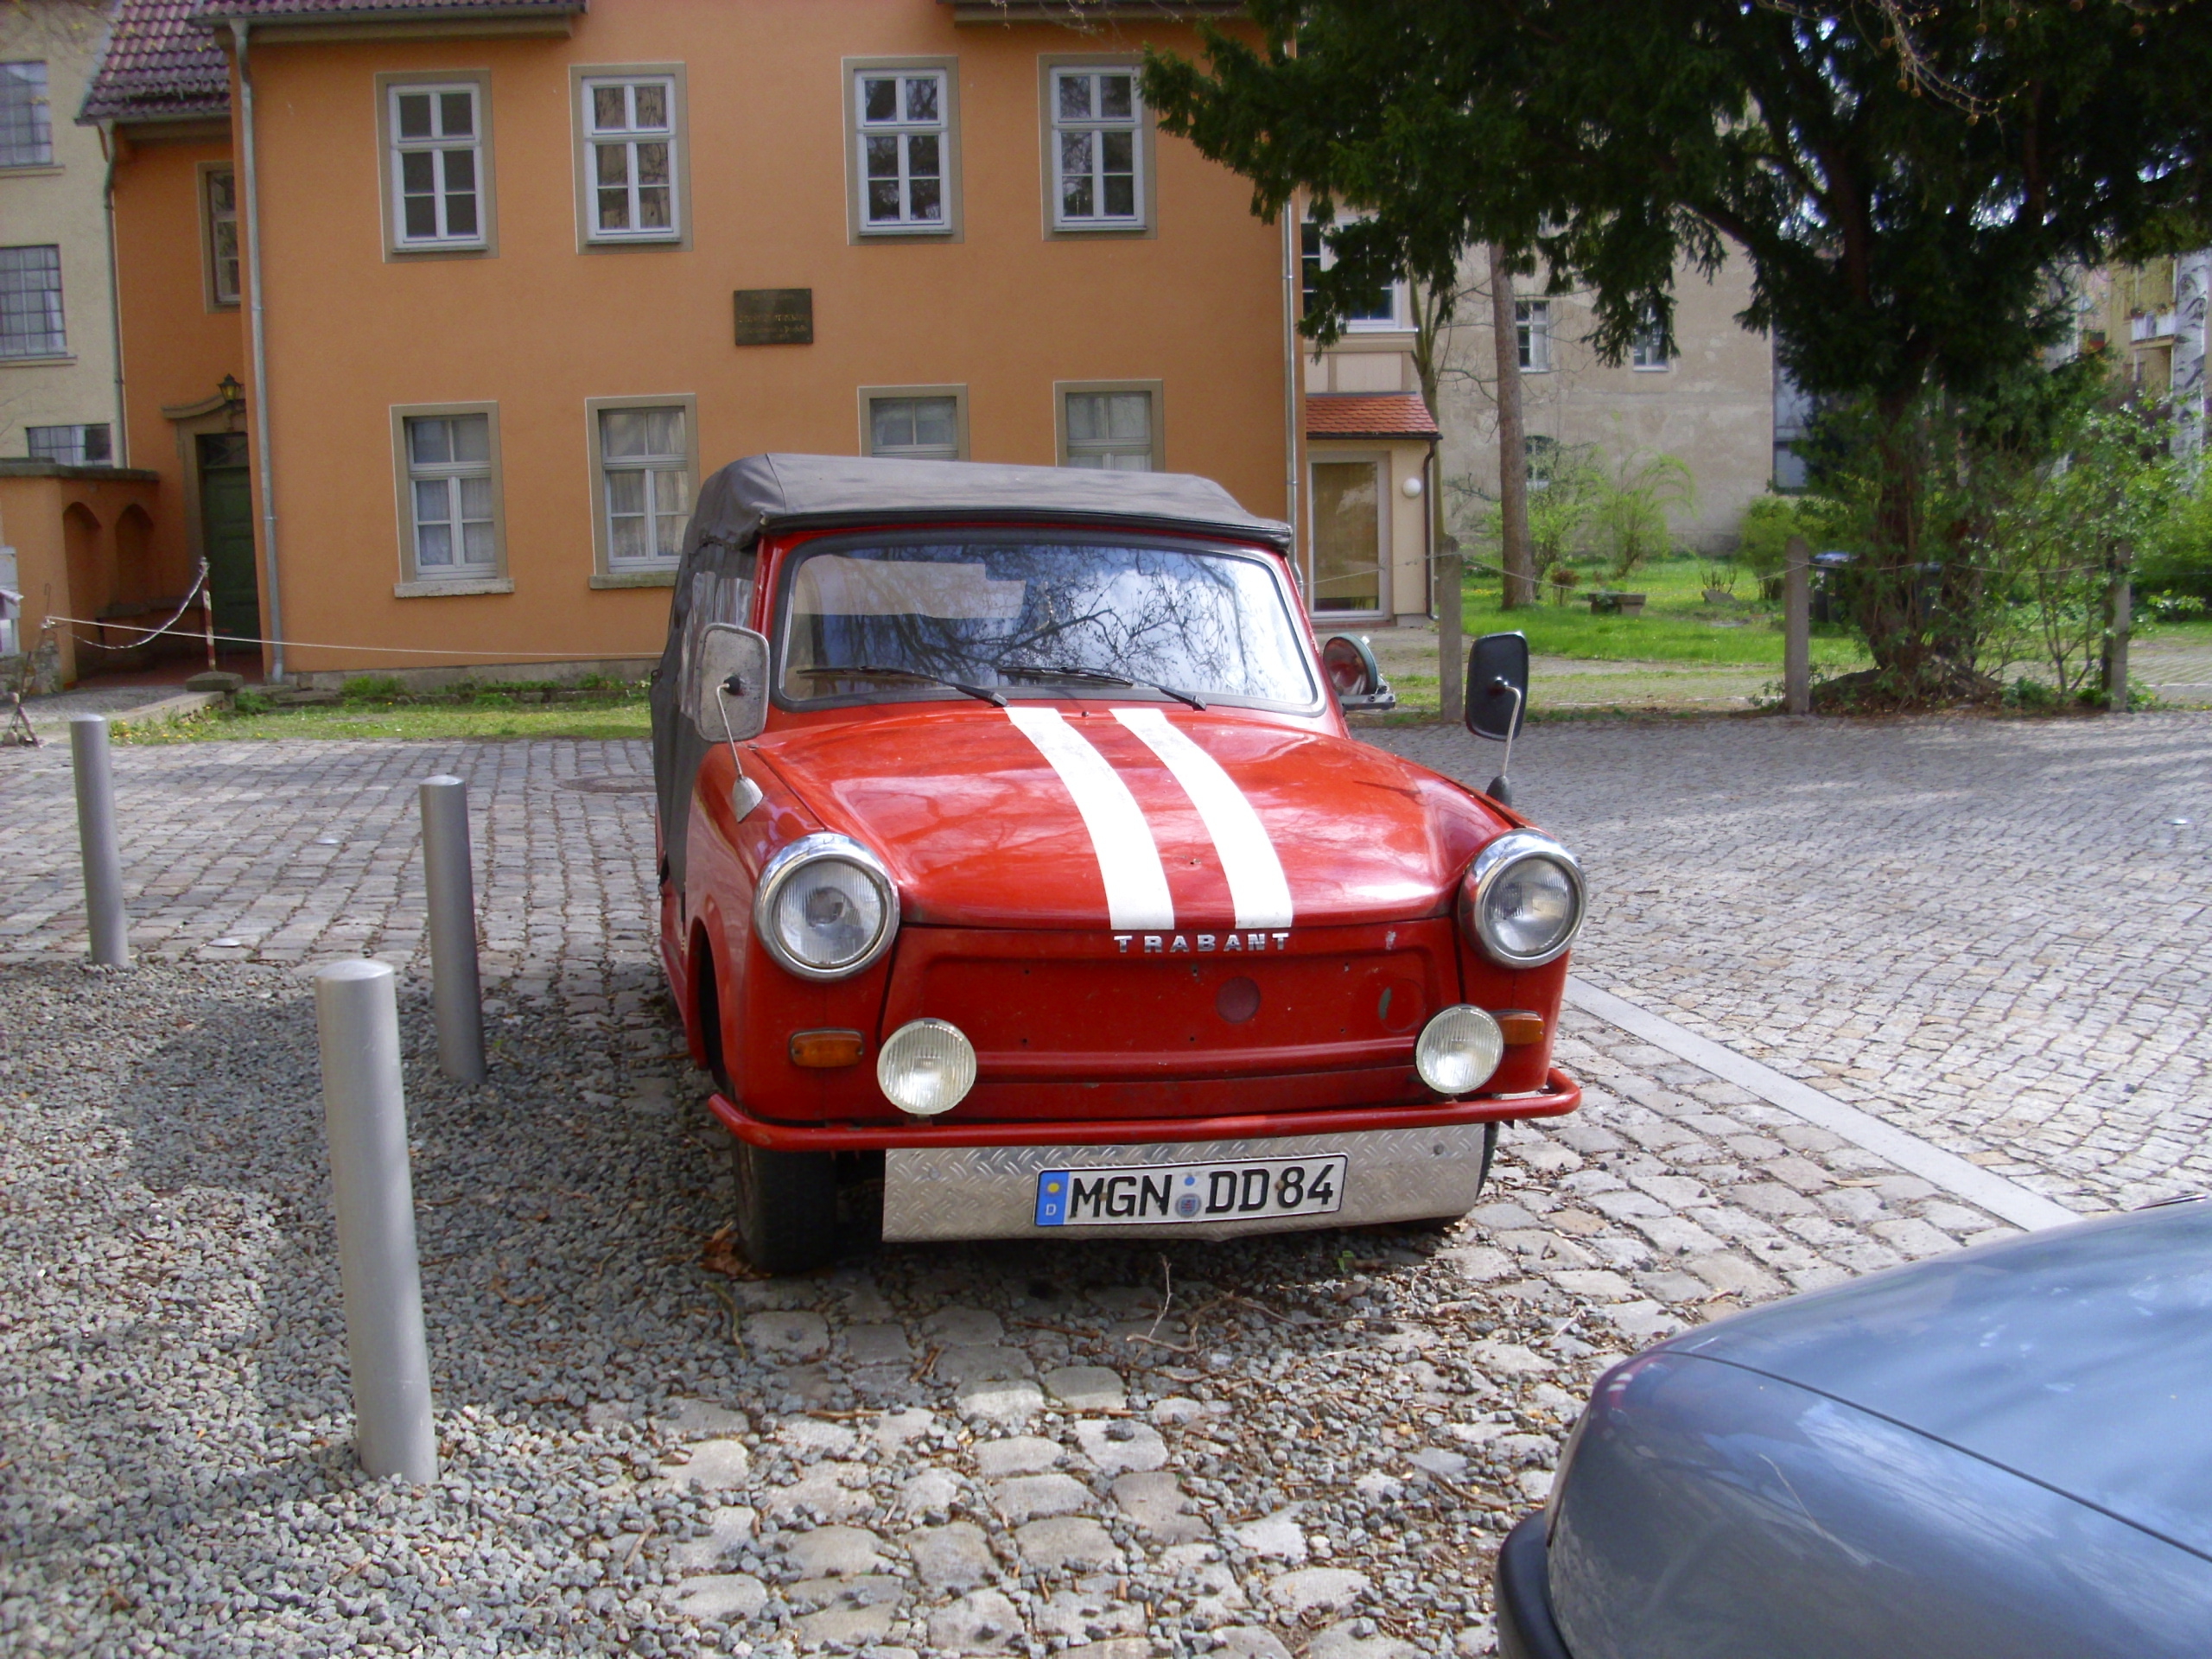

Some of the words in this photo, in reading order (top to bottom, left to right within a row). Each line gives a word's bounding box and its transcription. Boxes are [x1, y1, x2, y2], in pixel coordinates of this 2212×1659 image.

[1114, 932, 1290, 953] TRABANT
[1069, 1174, 1173, 1218] MGN
[1046, 1204, 1057, 1217] D
